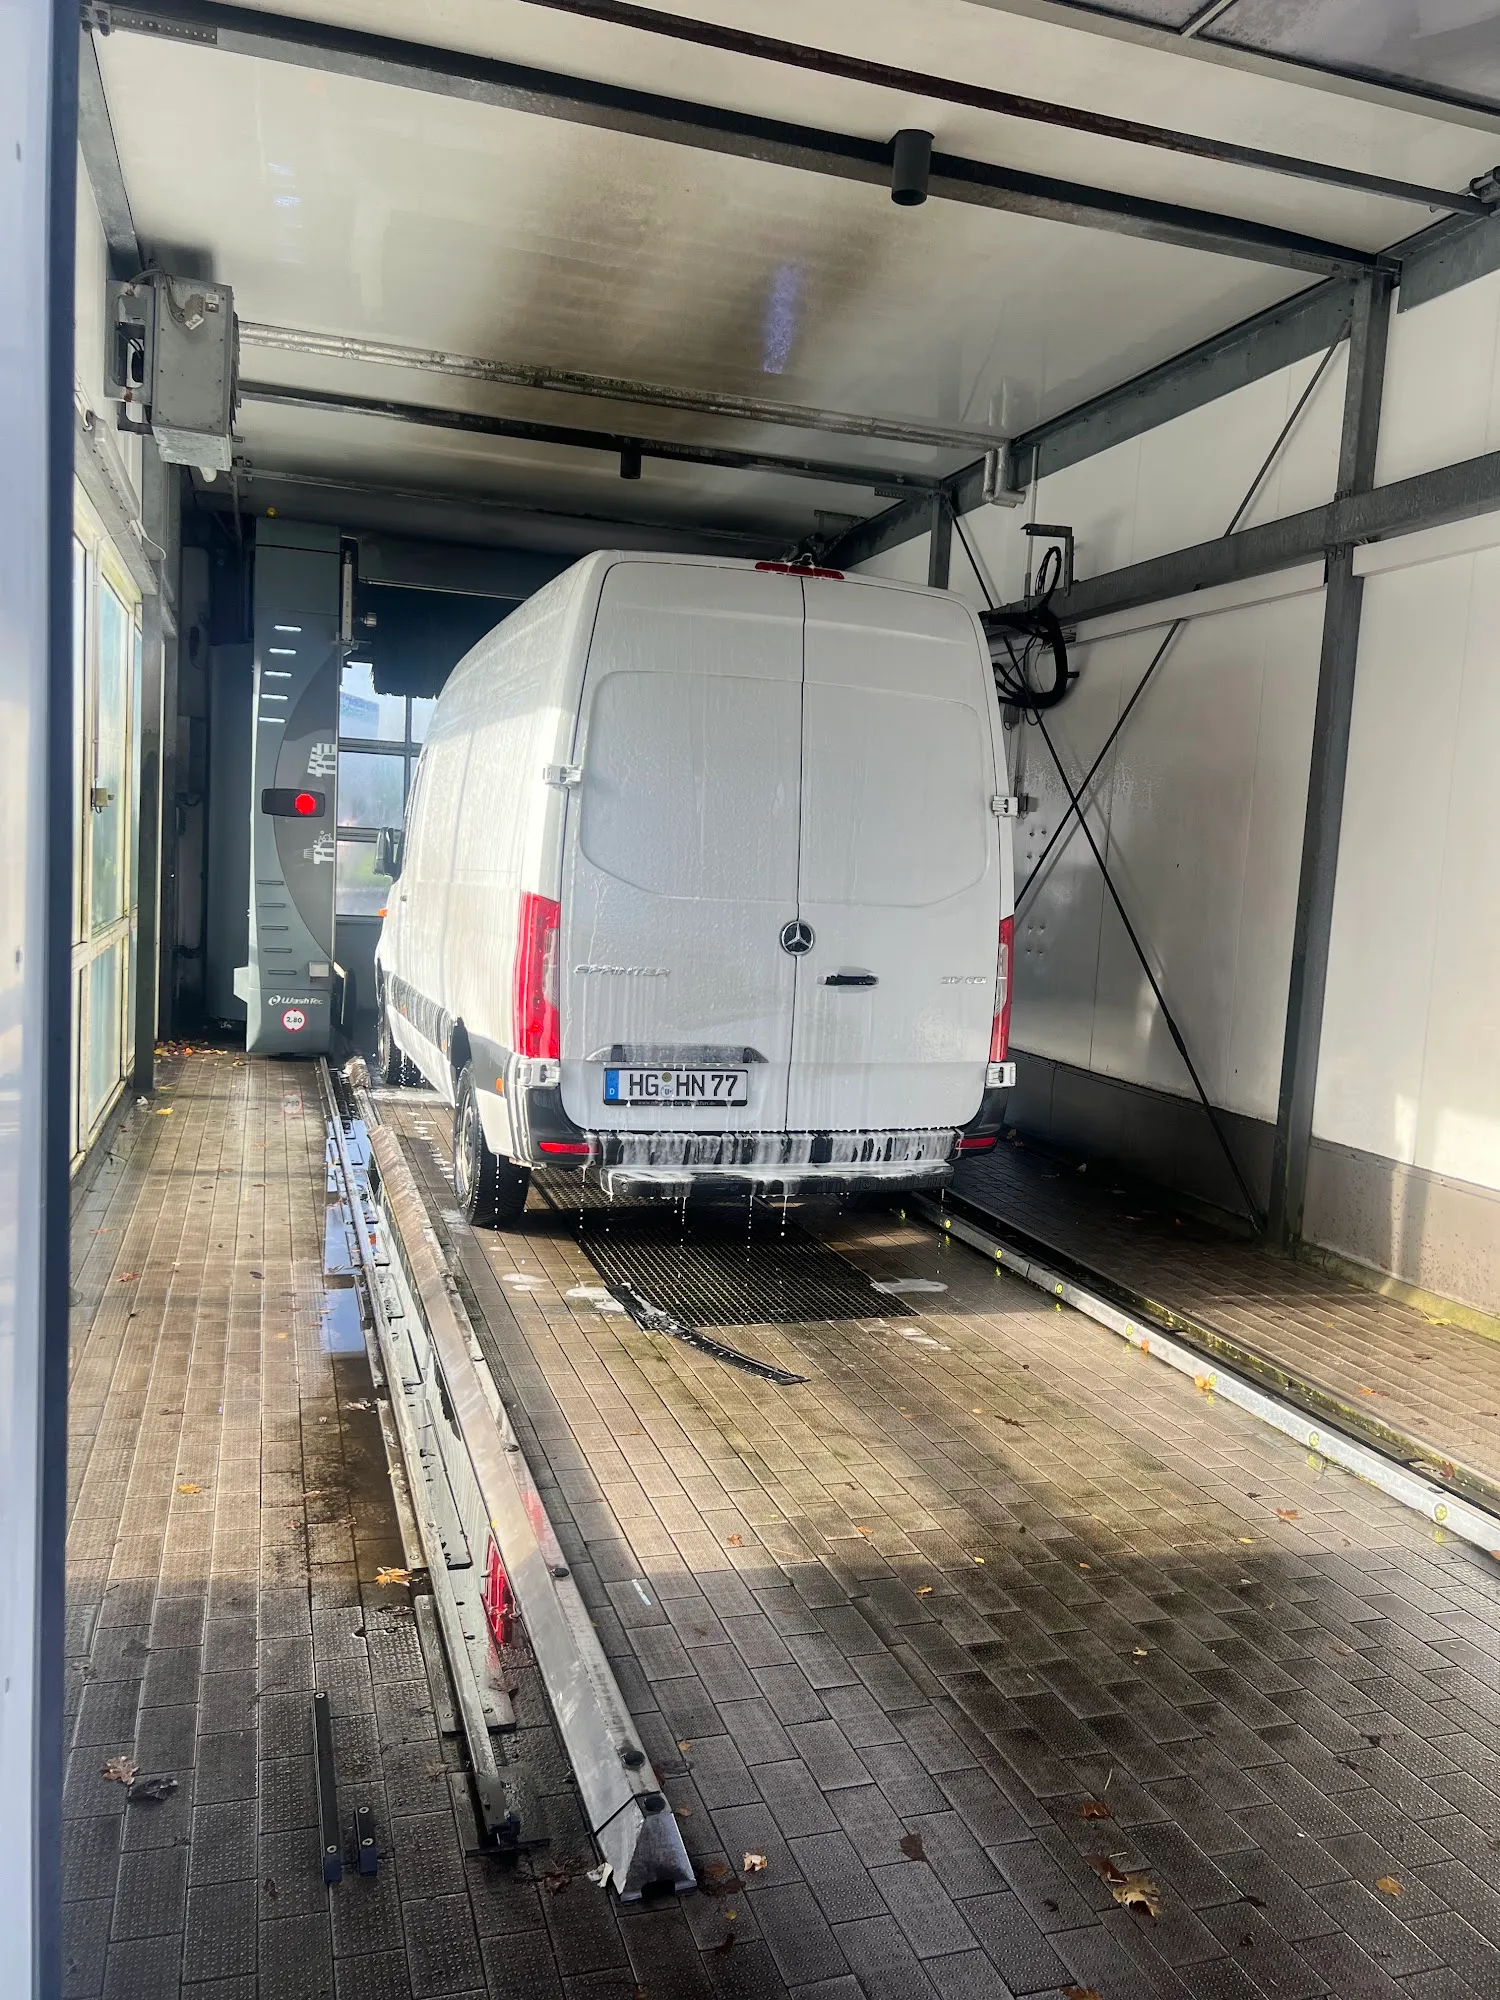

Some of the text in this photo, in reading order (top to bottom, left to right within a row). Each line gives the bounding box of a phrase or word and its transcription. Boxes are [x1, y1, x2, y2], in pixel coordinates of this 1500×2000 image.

[629, 1073, 659, 1097] HG
[676, 1074, 705, 1097] HN
[711, 1074, 738, 1097] 77
